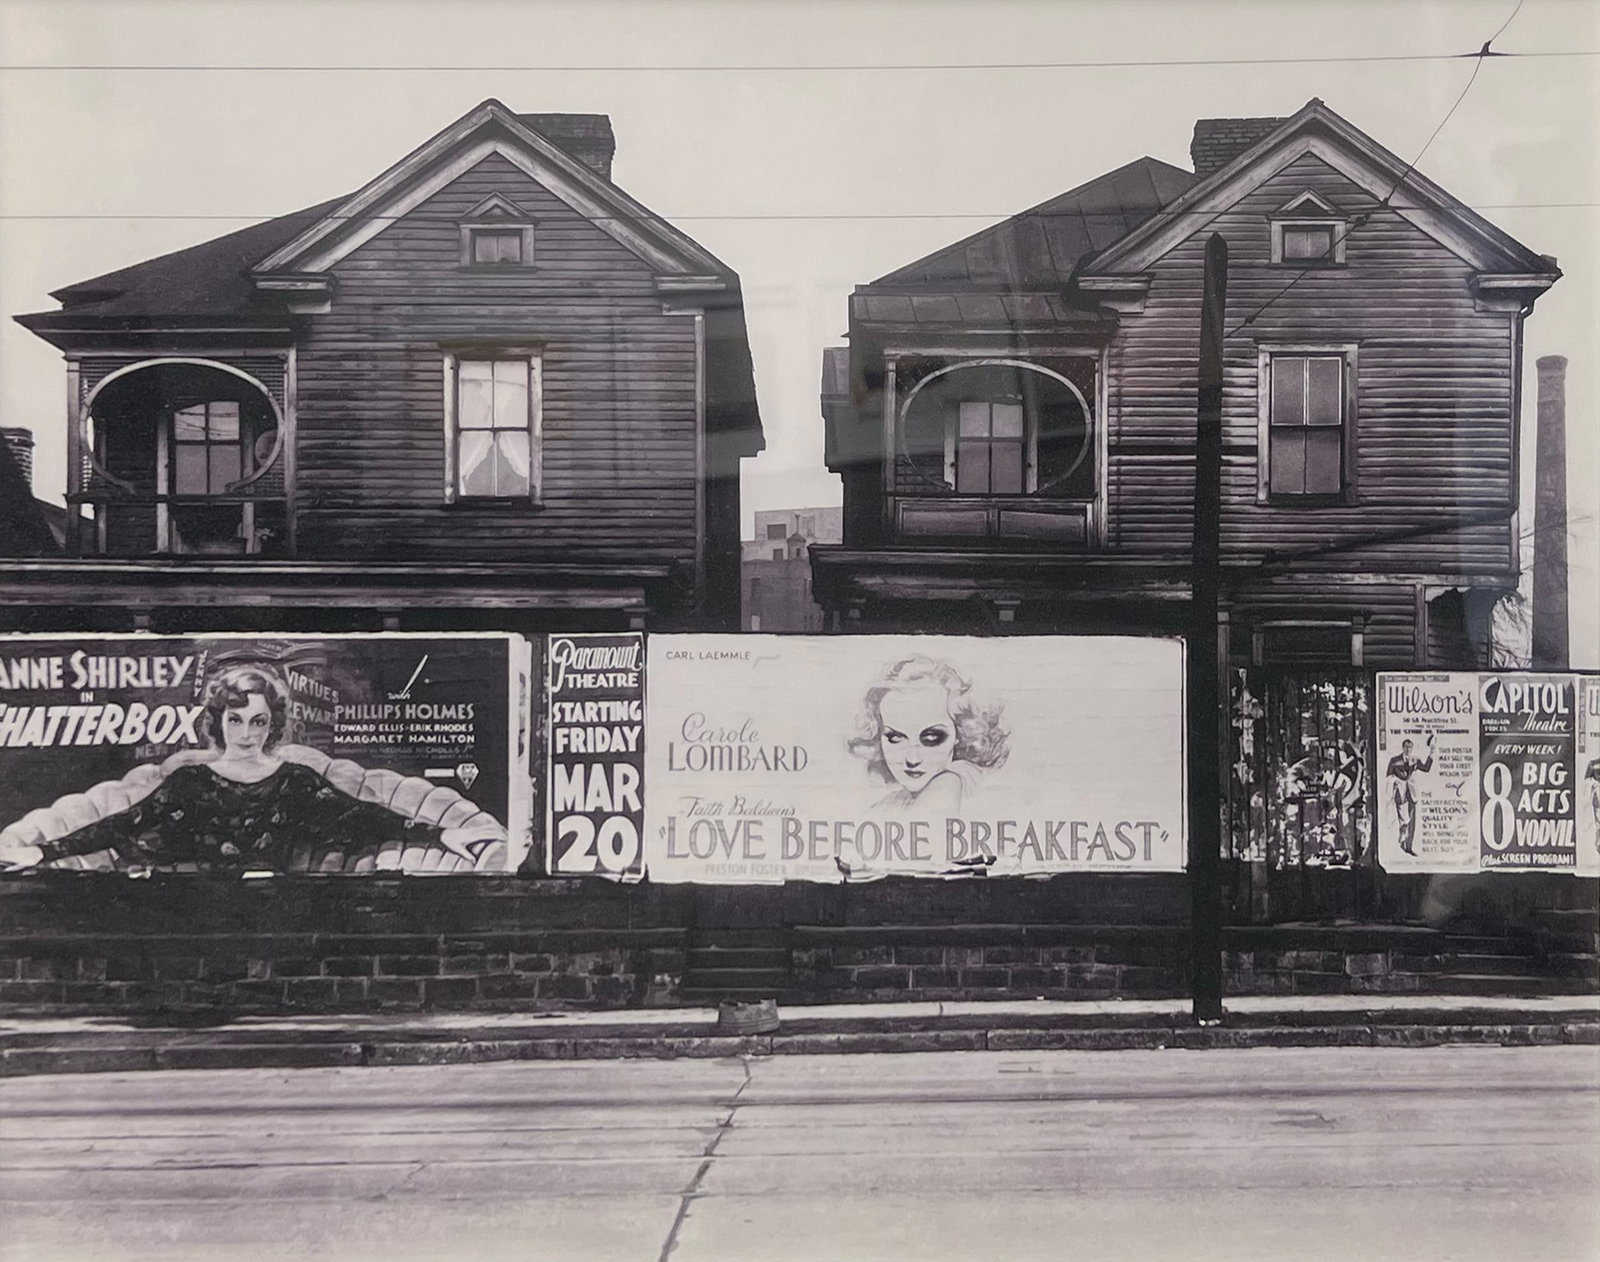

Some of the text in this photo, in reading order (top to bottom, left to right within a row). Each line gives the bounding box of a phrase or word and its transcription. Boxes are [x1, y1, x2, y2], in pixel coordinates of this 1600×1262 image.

[551, 639, 643, 693] Paramount
[666, 651, 751, 660] CARL LAEMMLE
[70, 650, 195, 690] SHIRLEY
[565, 672, 639, 688] THEATRE
[80, 691, 94, 702] IN
[283, 664, 339, 704] VIRTUES
[1480, 677, 1569, 714] CAPITOL
[285, 699, 337, 725] EWAR
[333, 703, 475, 721] PHILLIPS HOLMES
[552, 700, 642, 723] STARTING
[1389, 686, 1473, 714] Wilson's
[334, 723, 474, 732] EDWARD ELLIS ERIK RHODES
[681, 711, 759, 745] Carole
[1517, 709, 1573, 732] Theatre
[334, 735, 475, 743] MARGARET HAMILTON
[555, 725, 641, 754] FRIDAY
[1494, 744, 1526, 755] EVERY
[668, 741, 808, 772] LOMBARD
[1522, 762, 1568, 786] BIG
[554, 763, 642, 813] MAR
[679, 795, 796, 818] Faith Baldwin's
[1482, 762, 1516, 851] 8
[1517, 789, 1571, 814] ACTS
[1421, 815, 1453, 823] QUALITY
[557, 814, 639, 873] 20
[781, 817, 932, 862] BEFORE
[1515, 818, 1575, 847] VODVIL
[1502, 853, 1531, 864] SCREEN
